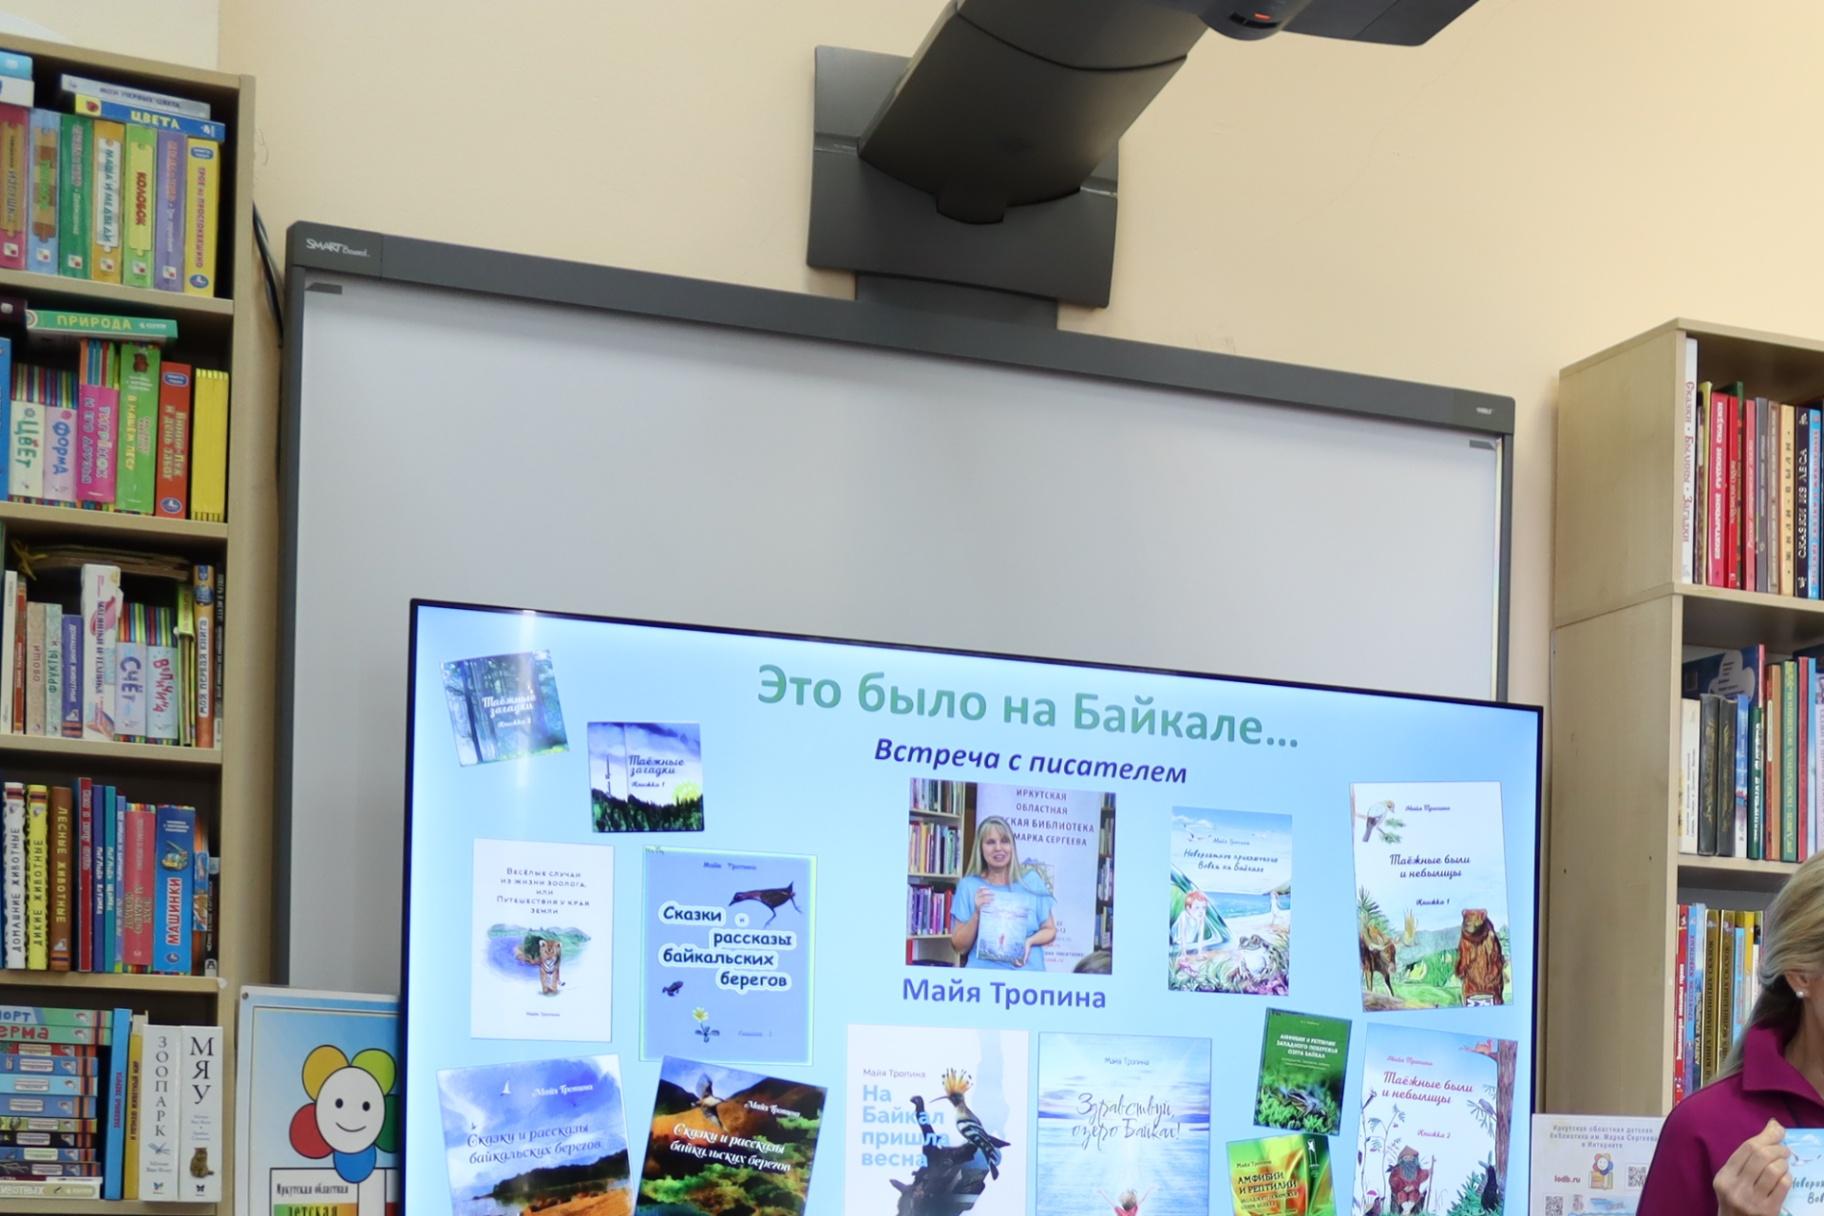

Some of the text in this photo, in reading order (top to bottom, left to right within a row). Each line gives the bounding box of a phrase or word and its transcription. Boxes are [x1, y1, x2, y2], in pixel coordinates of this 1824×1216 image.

[130, 110, 181, 130] ЦВЕТА
[135, 171, 148, 226] КОЛОБОК
[306, 238, 343, 254] SMART
[57, 315, 132, 330] ПРИРОДА
[757, 664, 1299, 748] Это было на Байкале...
[874, 737, 1187, 785] Встреча с писателем
[630, 766, 676, 777] загадки
[1016, 788, 1067, 801] ИРКУТСКАЯ
[1016, 803, 1068, 815] ОБЛАСТНАЯ
[1032, 818, 1095, 833] БИБЛИОТЕКА
[1014, 833, 1087, 847] МАРКА СЕРГЕЕВА
[56, 806, 68, 923] ЛЕСНЫЕ ЖИВОТНЫЕ
[1389, 853, 1471, 867] Таёжные были
[1411, 867, 1462, 880] небылицы
[32, 839, 43, 946] ДИКИЕ ЖИВОТНЫЕ
[166, 877, 181, 946] МАШИНКИ
[663, 905, 722, 922] Сказки
[713, 932, 792, 947] рассказы
[663, 948, 774, 966] байкальских
[720, 971, 788, 991] берегов
[902, 978, 1106, 1010] Майя Тропина
[189, 1036, 215, 1105] МЯУ
[863, 1068, 926, 1080] Майя Тропина
[155, 1035, 170, 1137] ЗООПАРК
[1383, 1071, 1474, 1093] Таёжные были
[862, 1084, 892, 1103] На
[1392, 1089, 1452, 1105] небылицы
[861, 1105, 944, 1125] Байкал
[467, 1131, 515, 1148] Сказки
[528, 1122, 589, 1144] рассказы
[673, 1122, 719, 1142] Сказки
[730, 1135, 785, 1155] рассказы
[861, 1130, 949, 1150] пришла
[469, 1139, 601, 1165] байкальских берегов
[670, 1140, 791, 1174] байкальских берегов
[861, 1151, 928, 1167] весна
